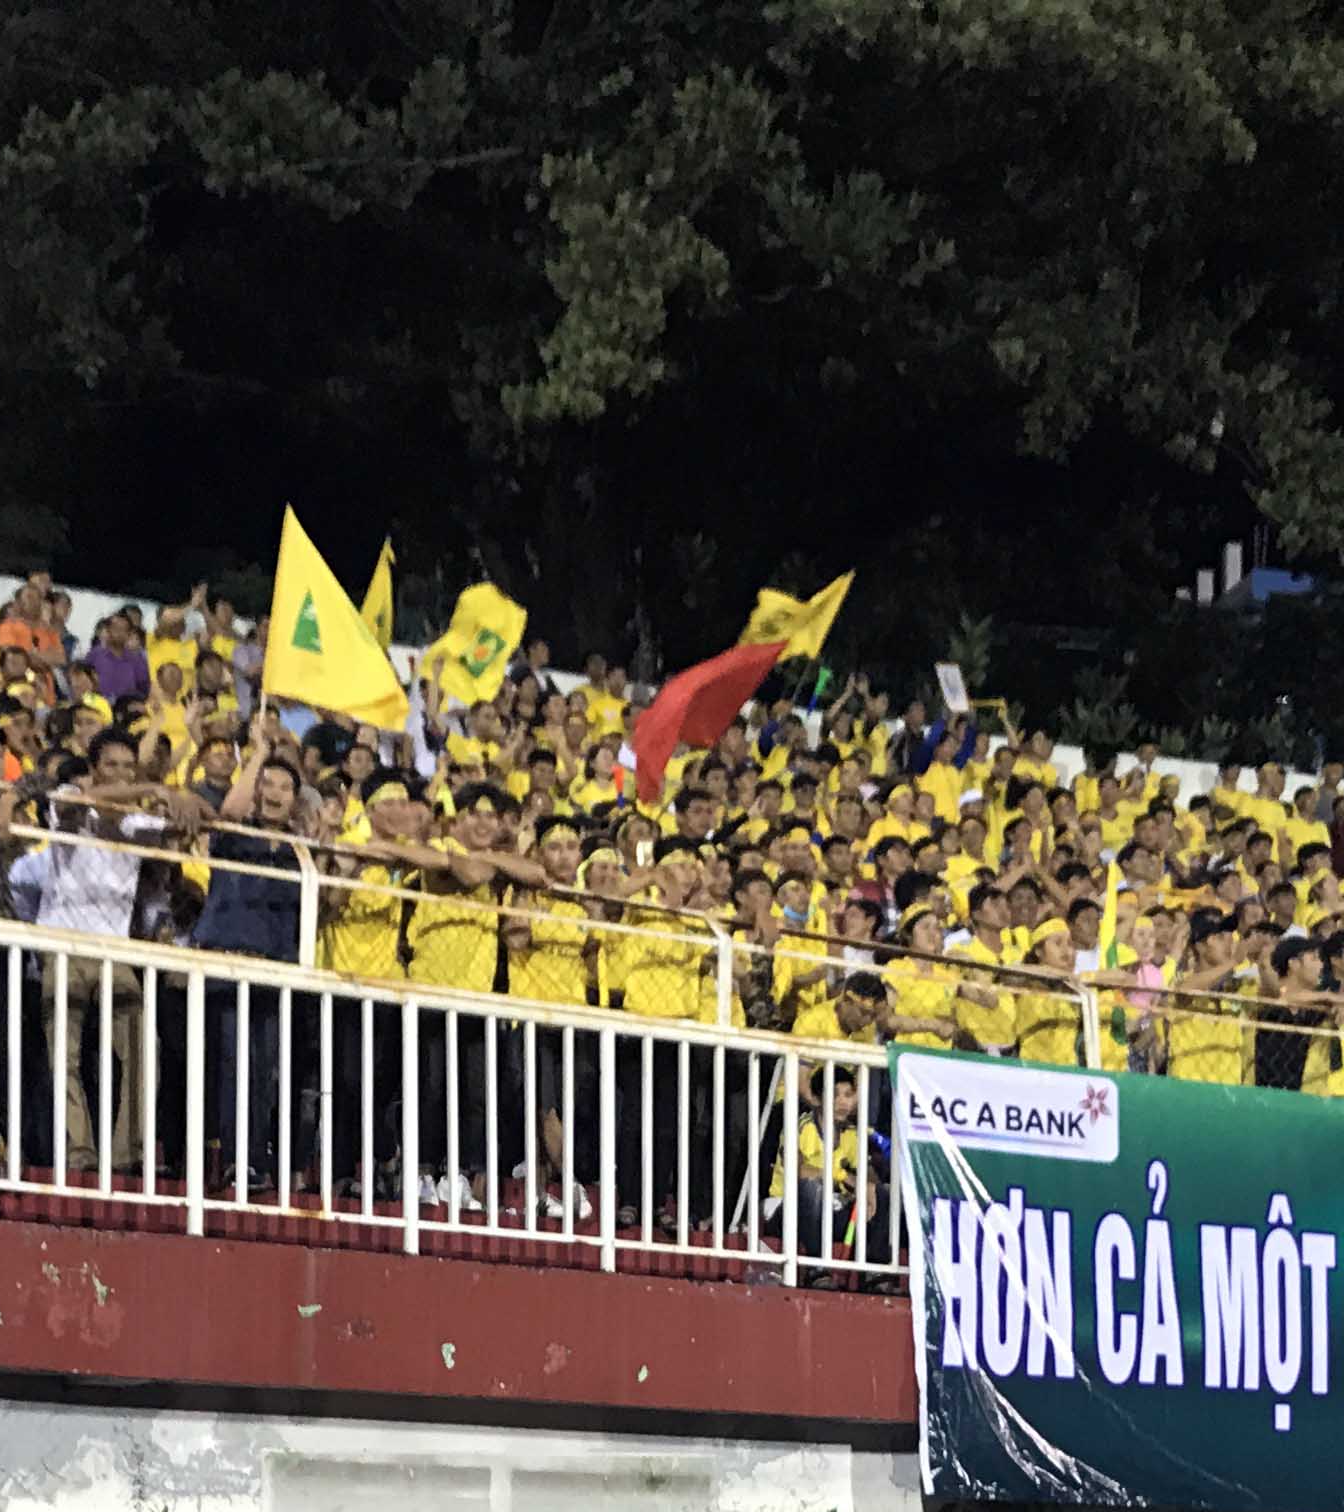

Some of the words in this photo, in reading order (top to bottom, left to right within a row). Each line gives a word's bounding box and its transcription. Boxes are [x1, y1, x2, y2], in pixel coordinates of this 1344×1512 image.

[977, 1102, 996, 1129] A
[1006, 1105, 1086, 1139] BANK
[933, 1188, 1075, 1378] HƠN
[1095, 1160, 1184, 1385] CẢ
[1200, 1194, 1336, 1430] MỘT
